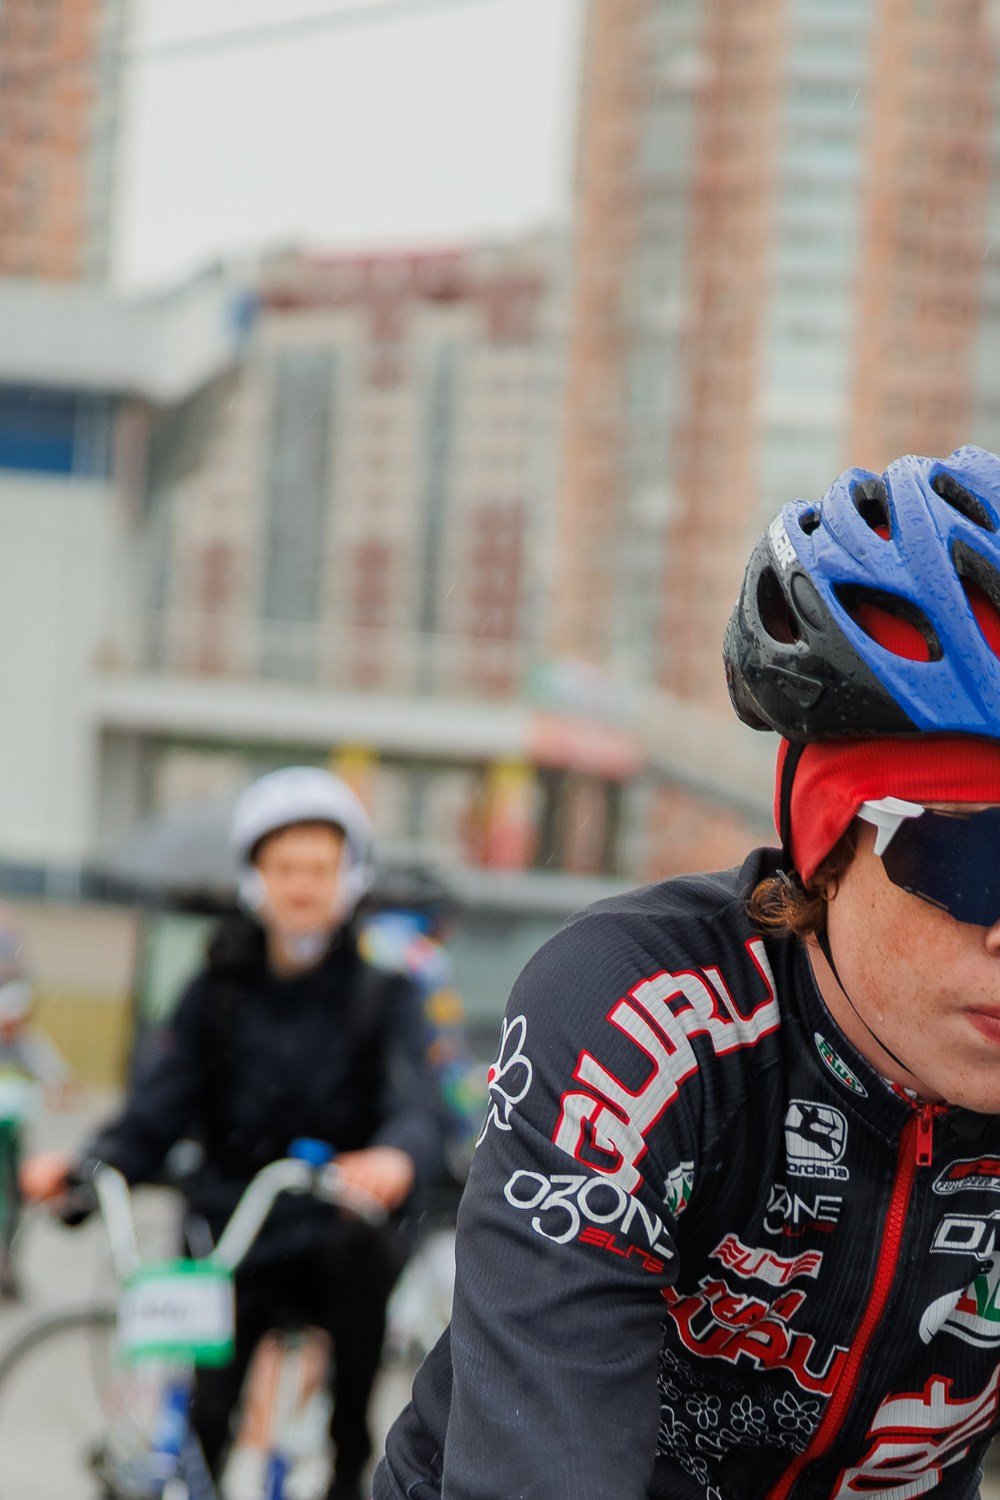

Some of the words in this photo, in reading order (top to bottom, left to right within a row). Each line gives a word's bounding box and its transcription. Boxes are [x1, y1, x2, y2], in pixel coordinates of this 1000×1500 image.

[552, 936, 781, 1196] GURU
[787, 1162, 848, 1180] ordana
[578, 1226, 665, 1274] ELITE
[714, 1237, 822, 1285] ELITE
